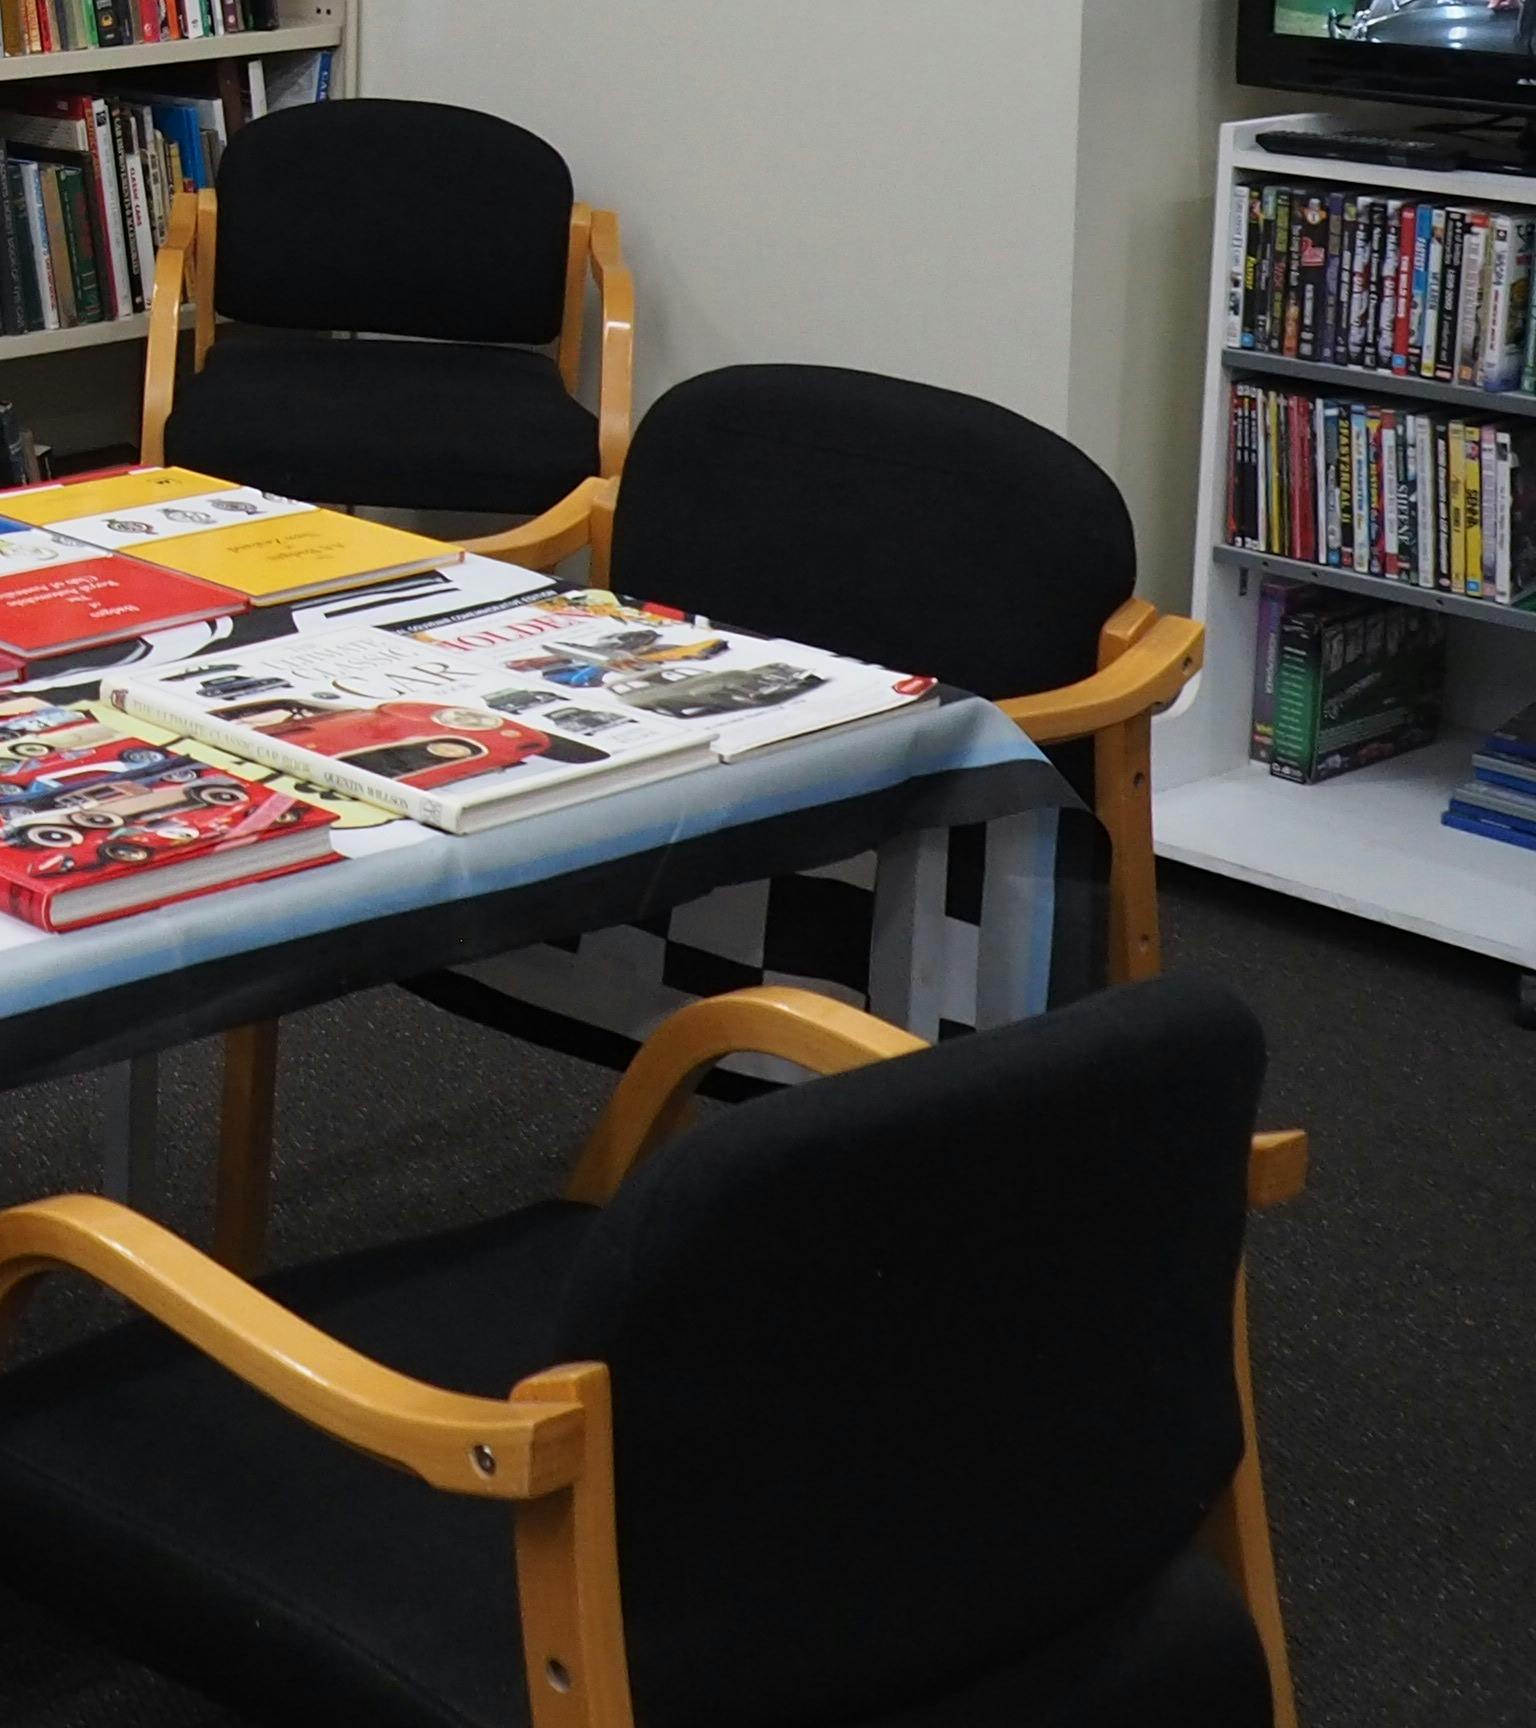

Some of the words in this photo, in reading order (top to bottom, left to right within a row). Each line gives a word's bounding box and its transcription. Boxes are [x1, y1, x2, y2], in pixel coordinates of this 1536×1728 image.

[1414, 237, 1426, 272] FASTEST
[1465, 489, 1478, 529] SENNA
[5, 586, 79, 609] Automobile
[65, 575, 100, 588] Club
[79, 578, 120, 593] Royal
[525, 590, 558, 606] EDITION
[289, 647, 420, 681] CLASSIC
[330, 660, 478, 699] CAR
[157, 703, 206, 735] ULTIMATE
[207, 725, 254, 752] CLASSIC
[255, 741, 280, 759] CAR
[280, 751, 312, 773] BOOK
[323, 771, 365, 797] QUENTIN
[363, 785, 410, 810] WILLSON
